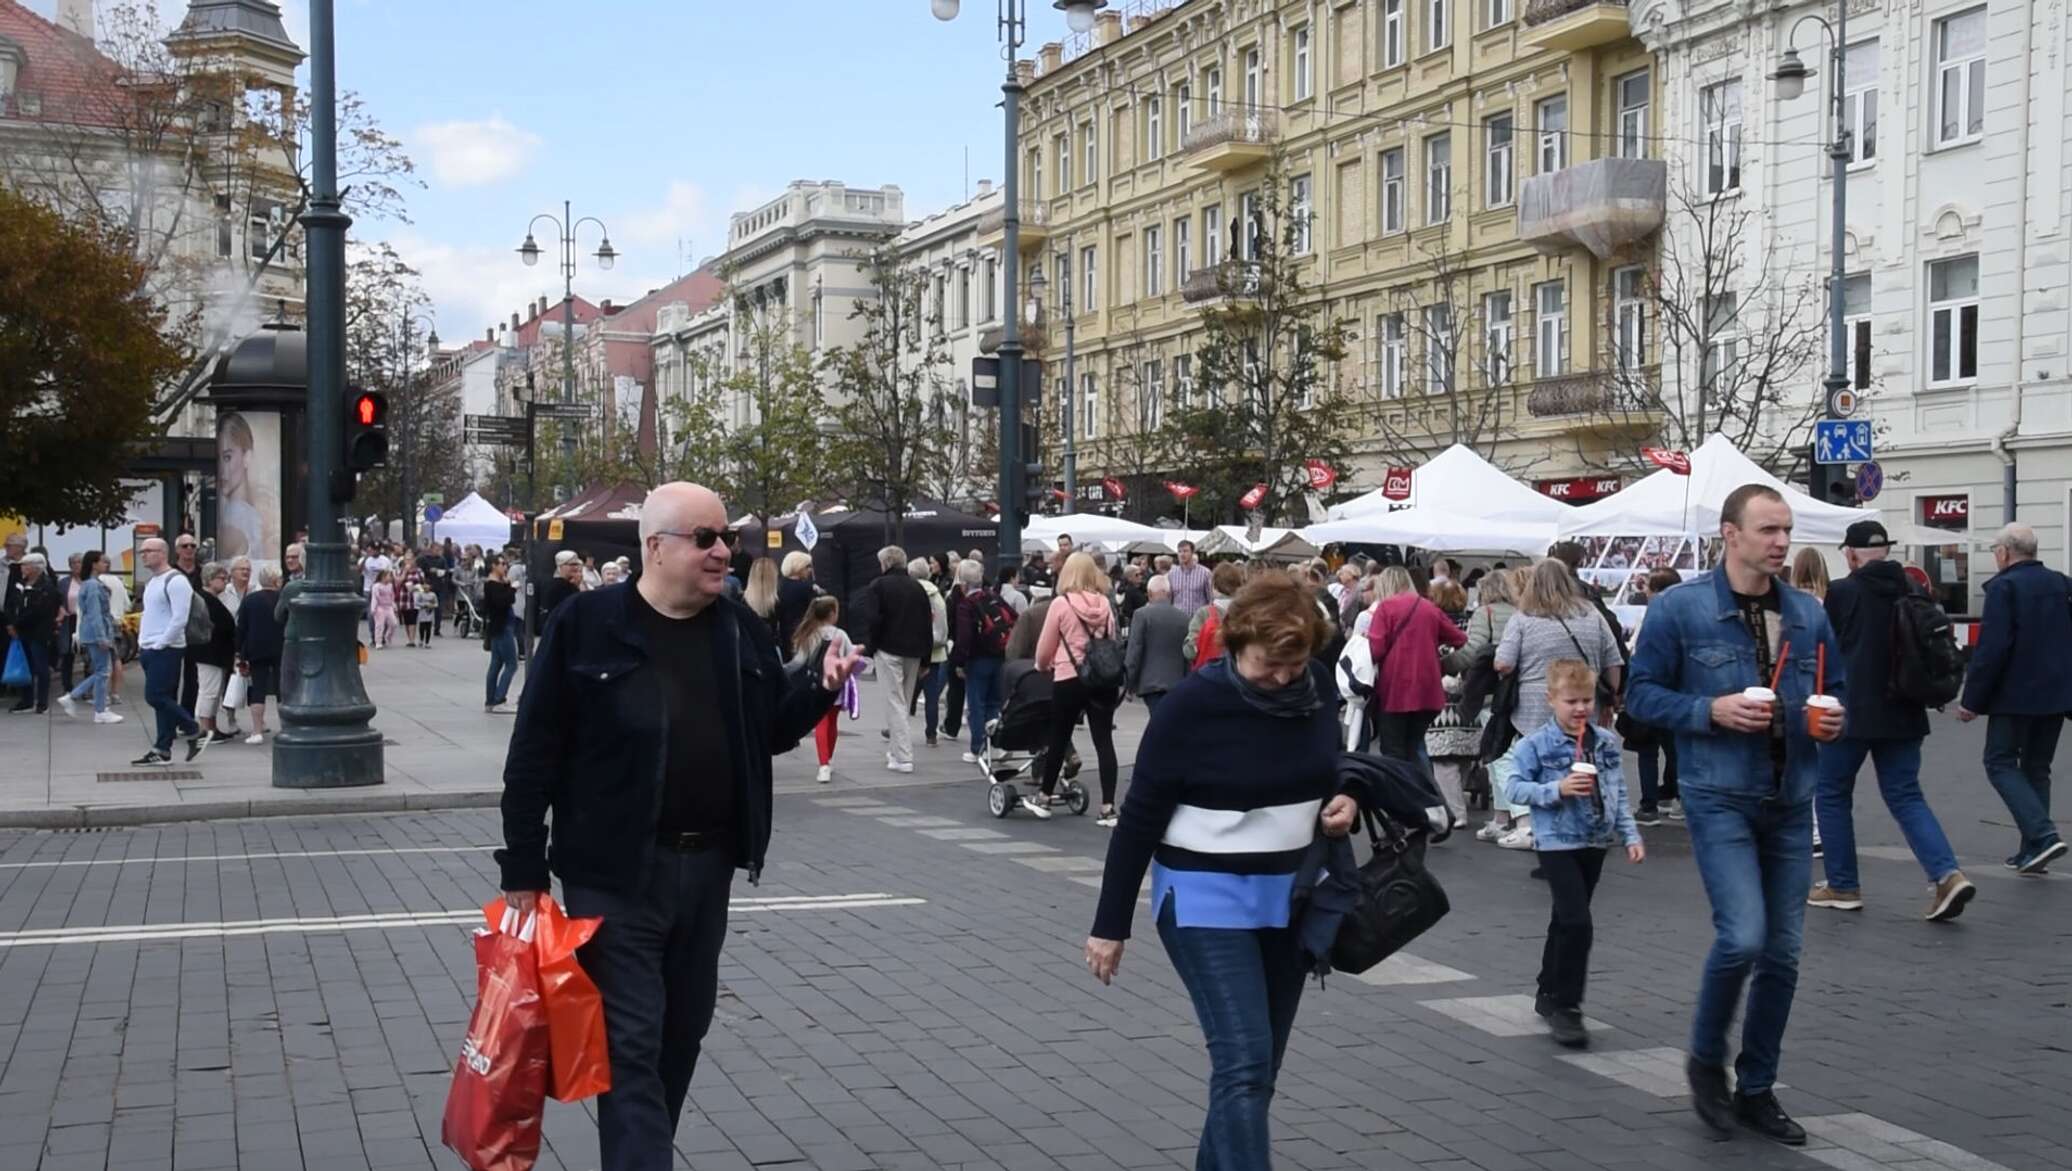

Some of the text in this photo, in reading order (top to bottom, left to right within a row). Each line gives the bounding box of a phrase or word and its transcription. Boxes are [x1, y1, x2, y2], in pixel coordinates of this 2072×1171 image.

[1550, 483, 1571, 495] KFC
[1596, 480, 1618, 493] KFC
[1934, 500, 1967, 514] KFC
